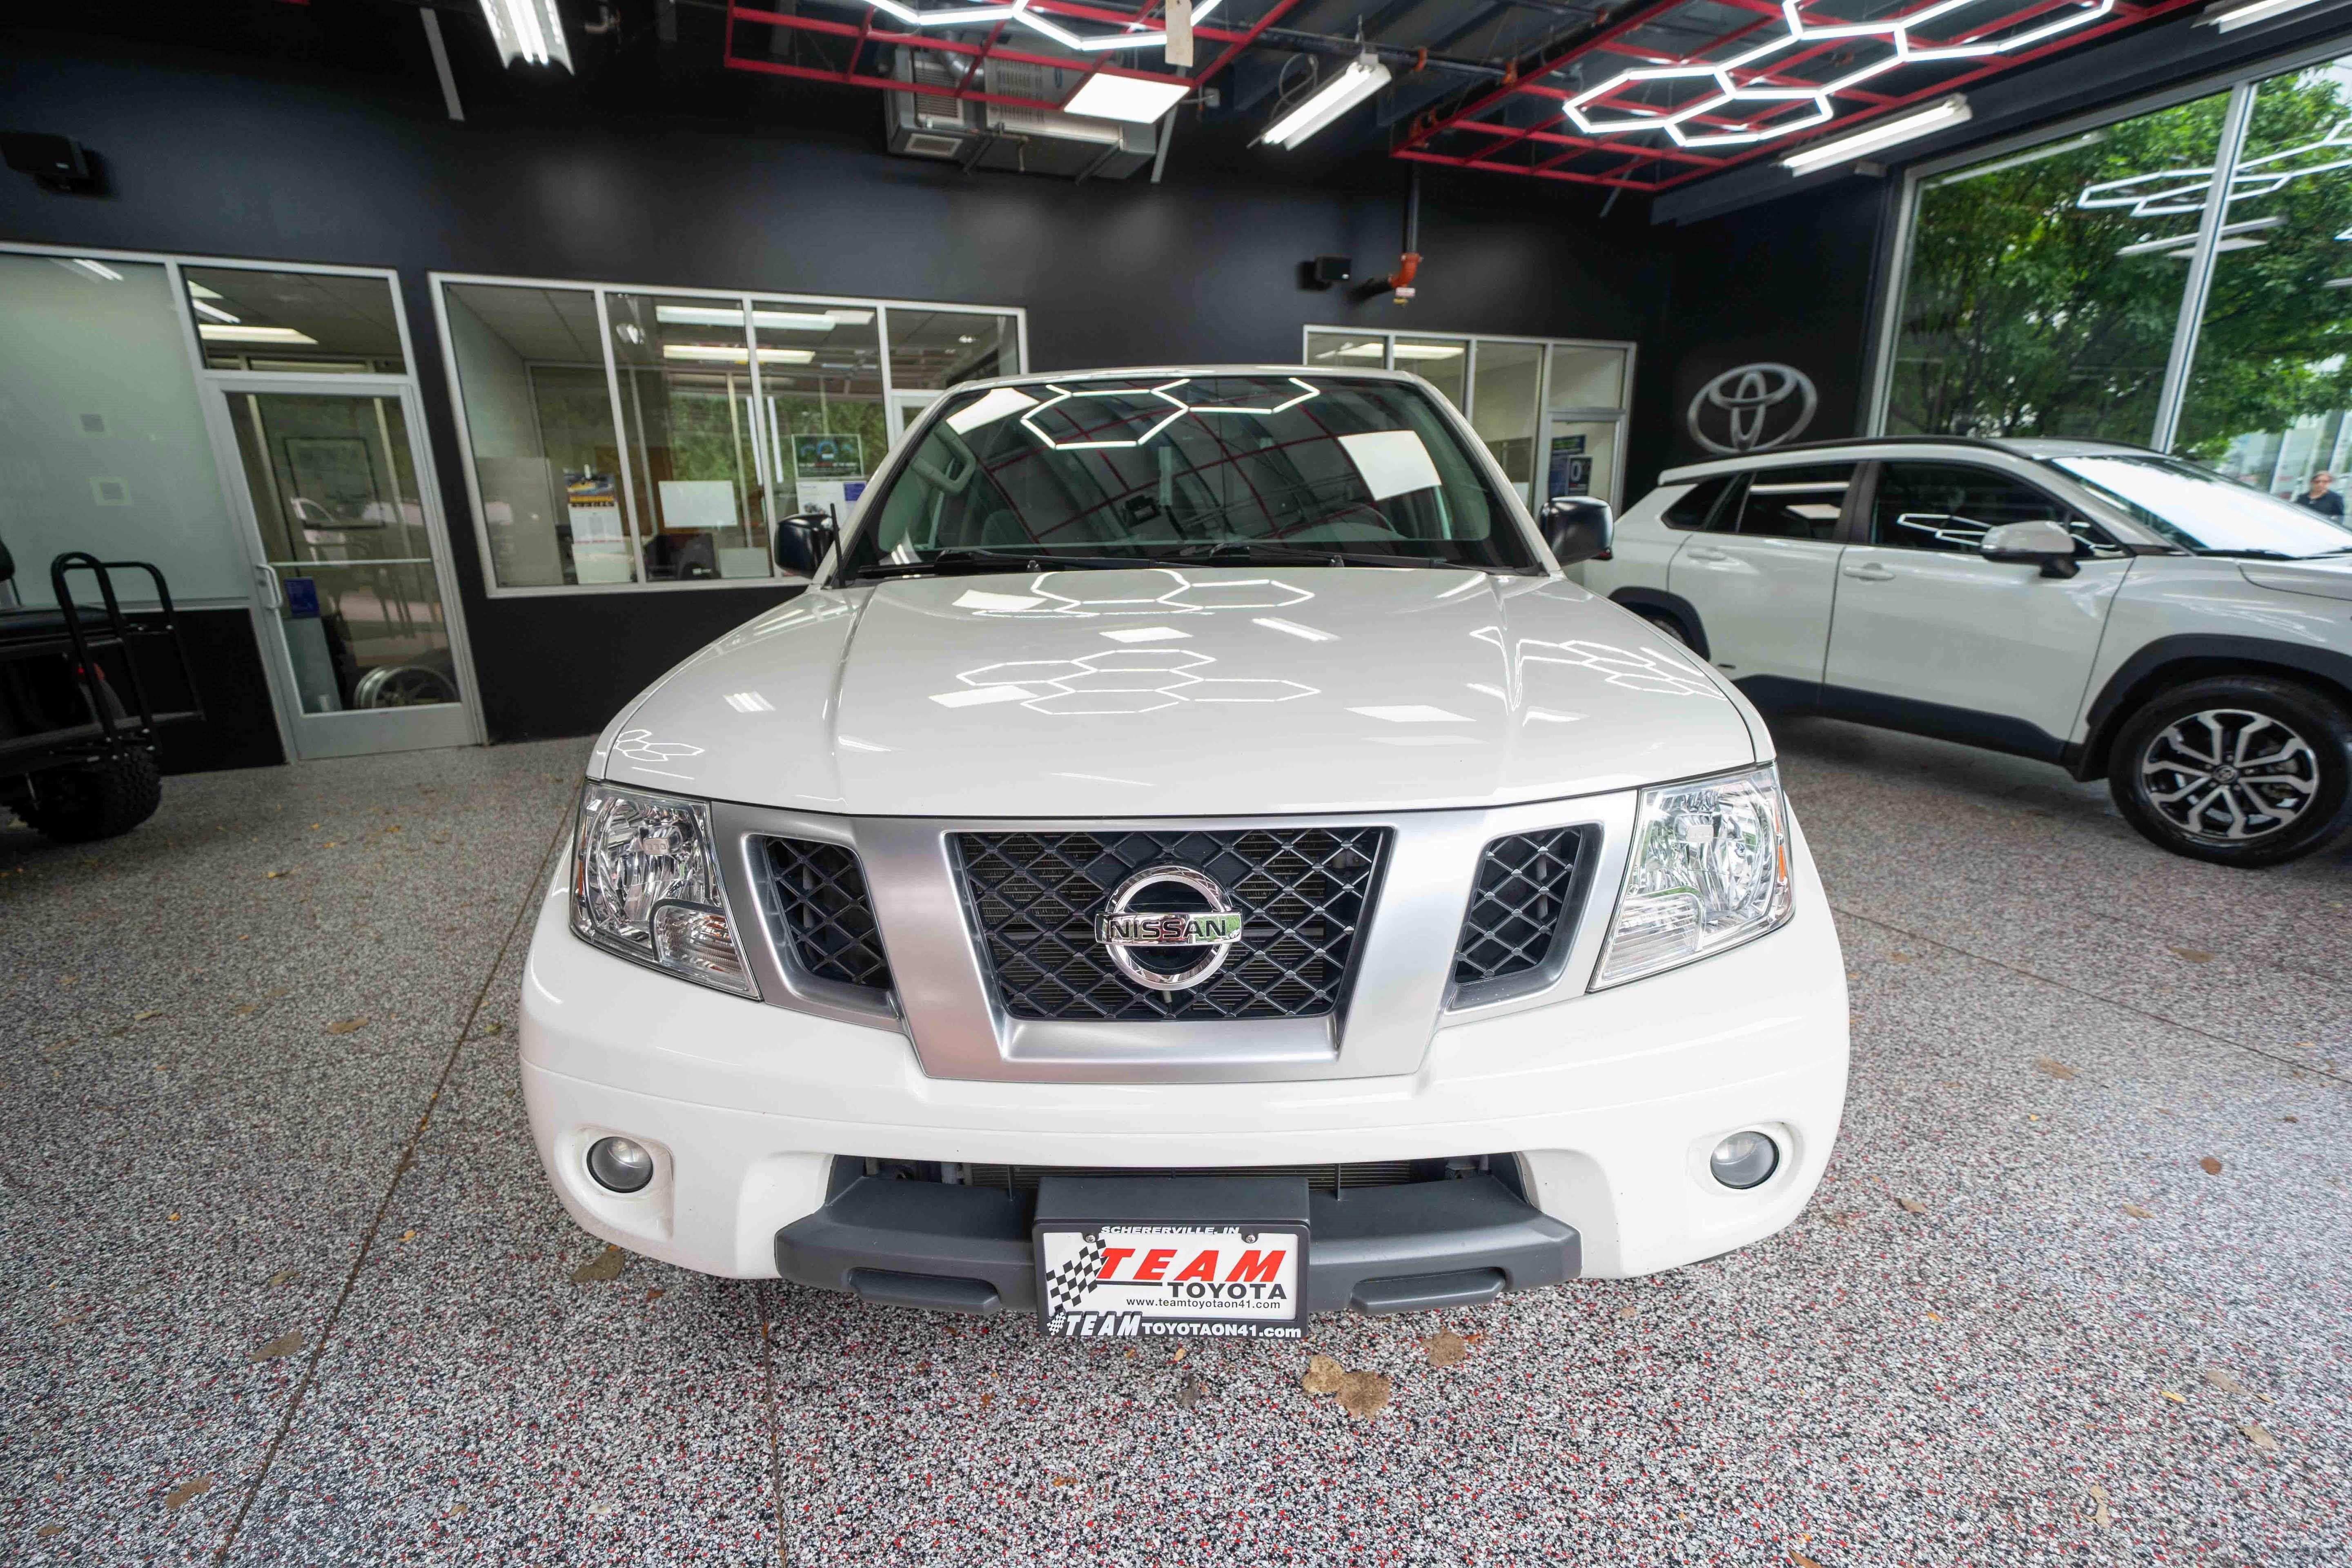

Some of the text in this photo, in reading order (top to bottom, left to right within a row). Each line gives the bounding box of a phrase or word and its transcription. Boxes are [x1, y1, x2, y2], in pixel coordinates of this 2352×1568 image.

[1109, 920, 1226, 938] NISSAN
[1096, 1248, 1286, 1282] TEAM
[1167, 1282, 1287, 1299] TOYOTA
[1126, 1298, 1281, 1309] www.teamtoyotaon41.com
[1065, 1314, 1301, 1338] TEAM TOYOTAON41.com
